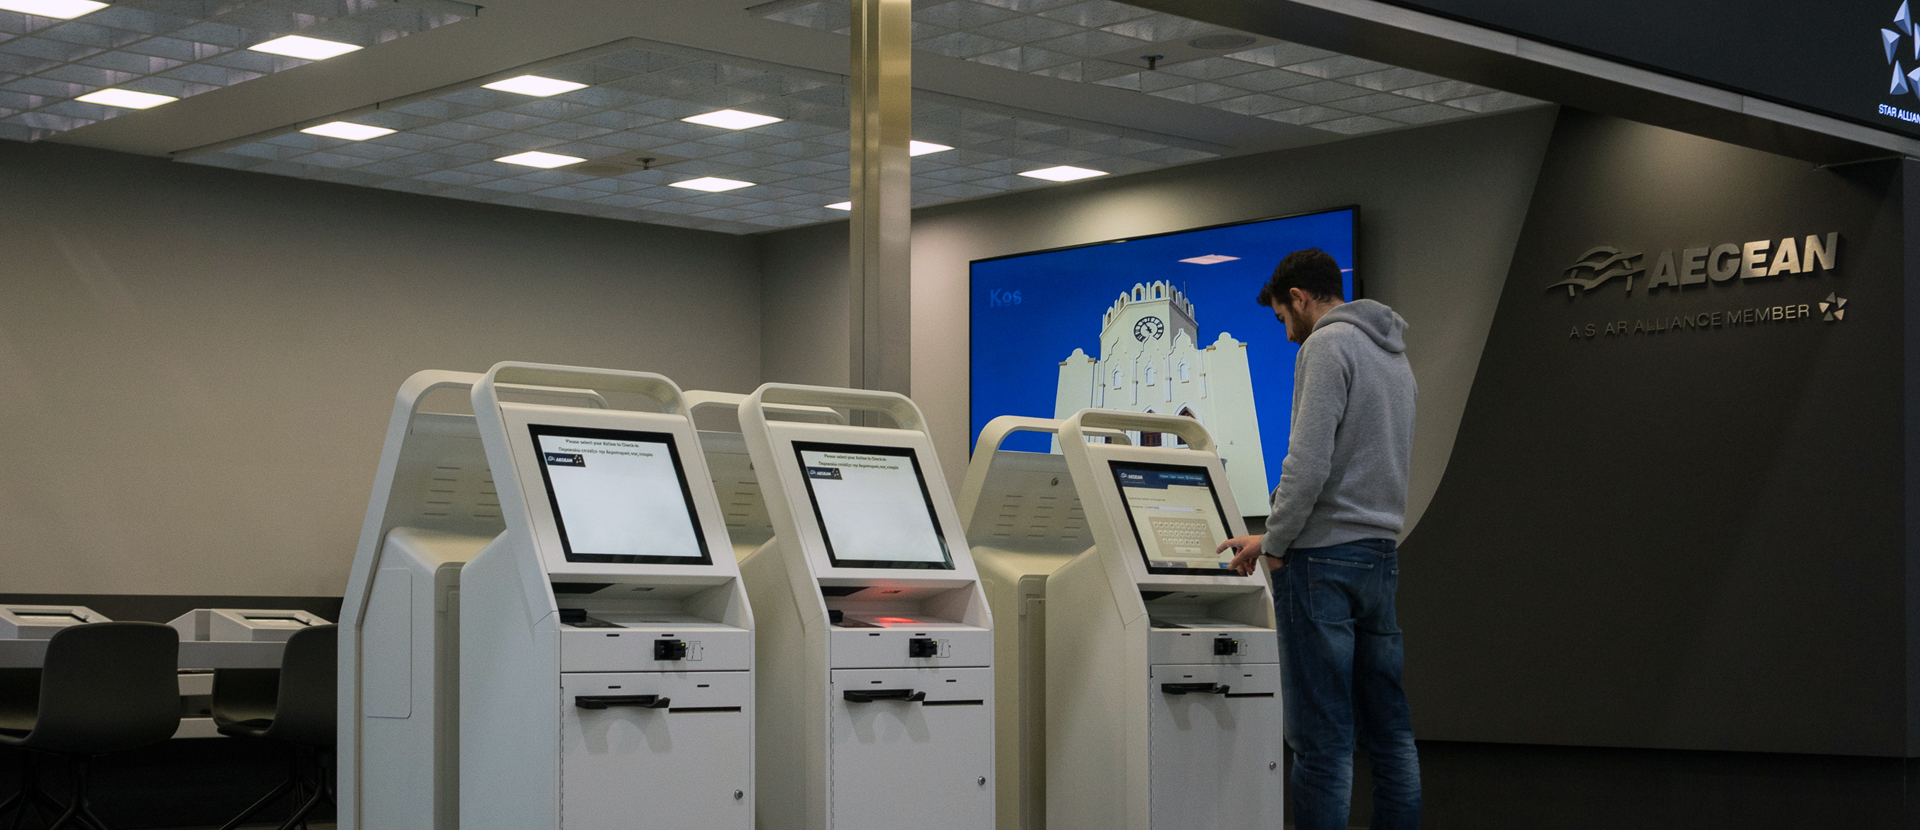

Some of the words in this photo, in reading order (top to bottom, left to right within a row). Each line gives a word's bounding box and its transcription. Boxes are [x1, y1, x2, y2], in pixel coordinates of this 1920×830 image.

[1878, 103, 1897, 118] STAR
[1647, 231, 1840, 290] AEGEAN
[990, 287, 1022, 308] Kos
[1569, 325, 1581, 339] A
[1633, 312, 1722, 333] ALLIANCE
[1726, 304, 1811, 326] MEMBER
